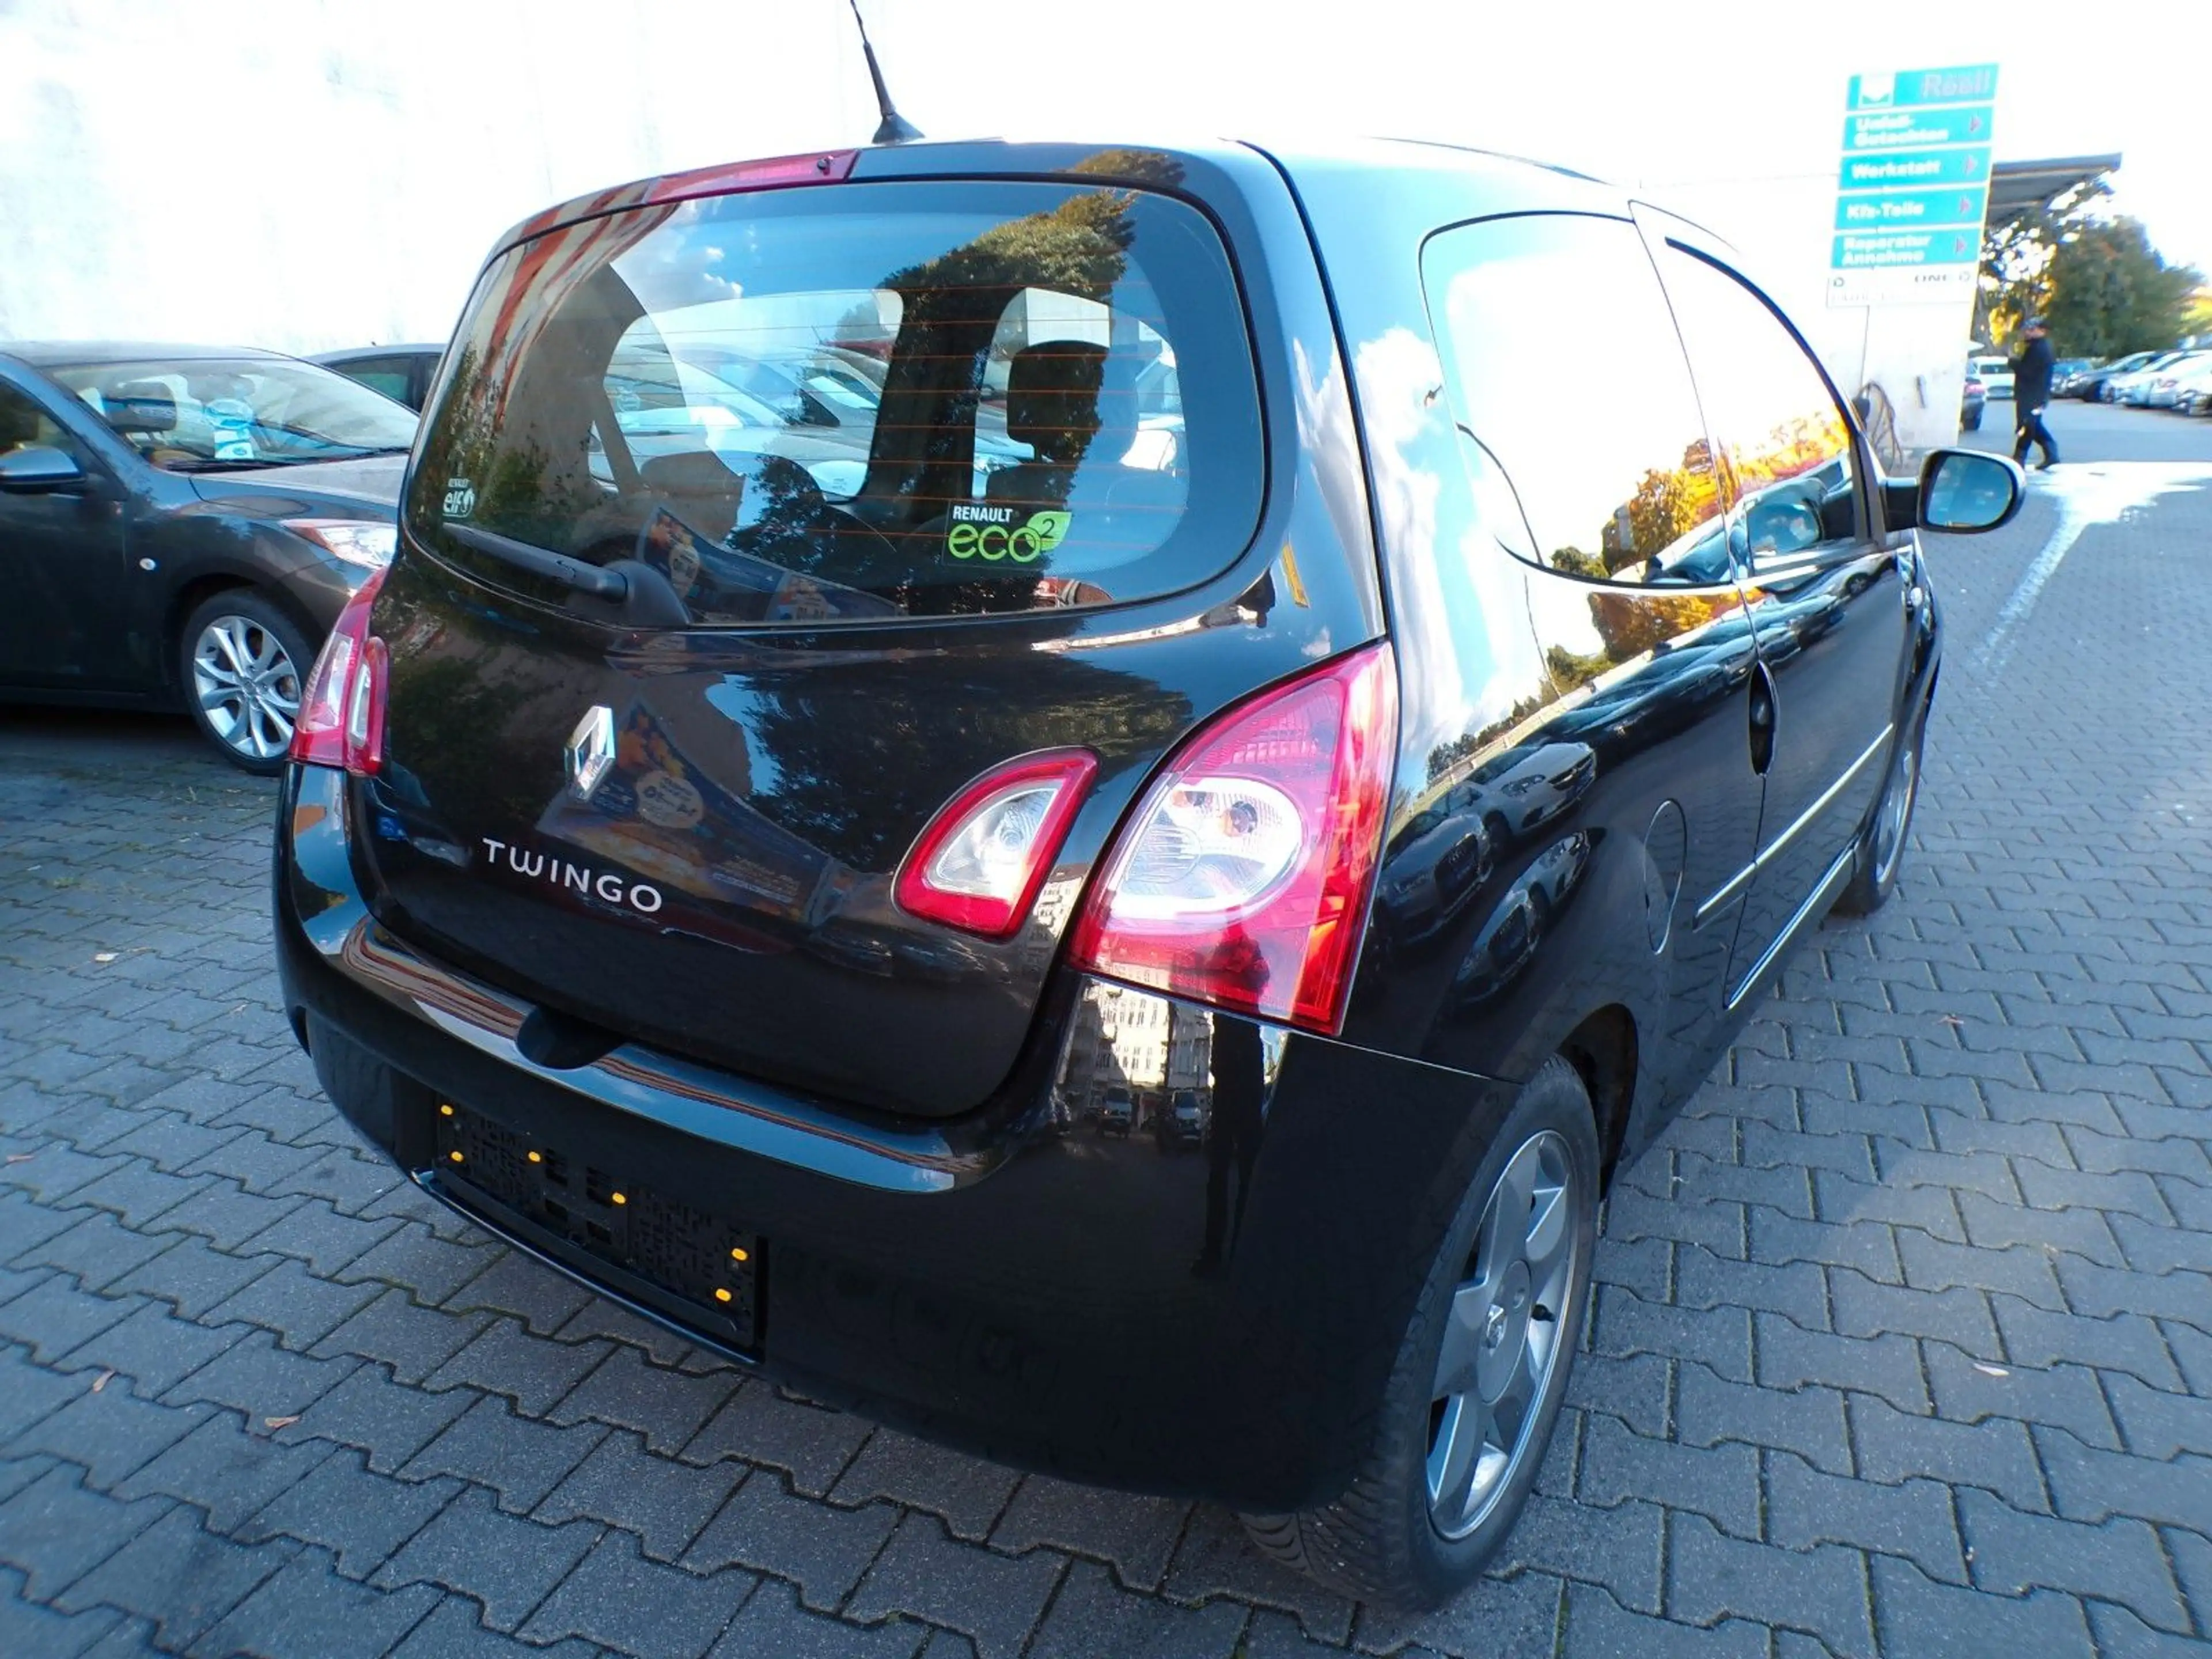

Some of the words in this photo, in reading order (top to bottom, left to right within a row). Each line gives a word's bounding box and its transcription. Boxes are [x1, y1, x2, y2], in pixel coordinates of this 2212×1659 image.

[1852, 160, 1941, 179] Werkstatt
[952, 506, 1013, 522] RENAULT
[482, 838, 662, 912] TWINGO
